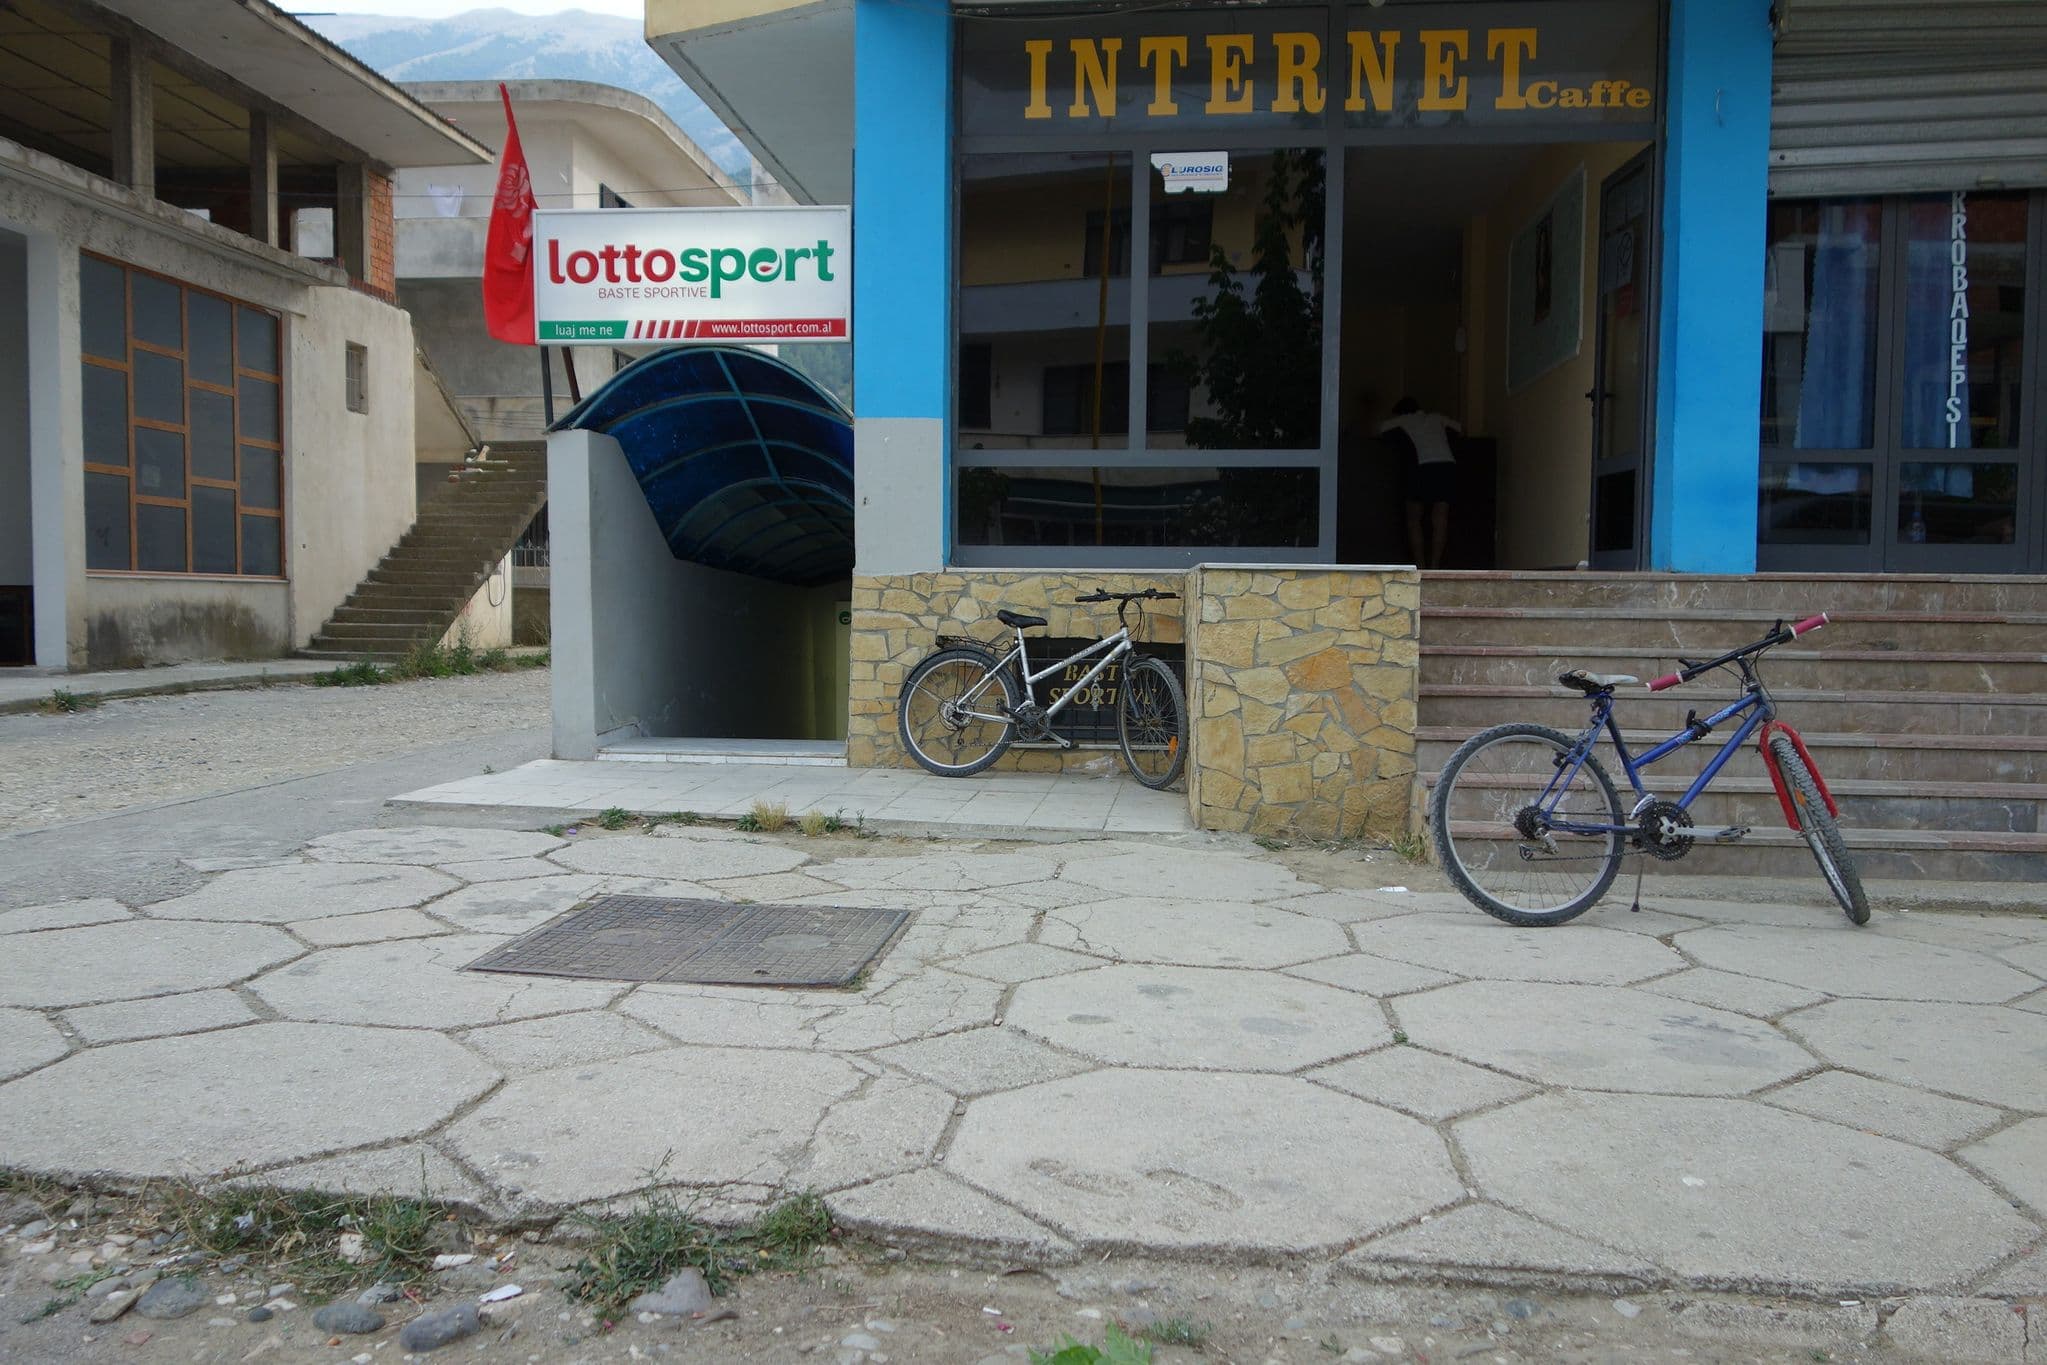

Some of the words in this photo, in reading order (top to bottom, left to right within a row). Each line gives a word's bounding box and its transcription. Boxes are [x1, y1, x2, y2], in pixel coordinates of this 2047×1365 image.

[1024, 28, 1537, 118] INTERNET
[1524, 80, 1651, 108] Caffe
[548, 239, 834, 298] lottosport
[598, 287, 640, 299] BASTE
[643, 286, 707, 299] SPORTIVE
[555, 324, 575, 338] luaj
[579, 326, 596, 335] me
[599, 326, 613, 335] ne
[711, 321, 832, 335] www.lottosport.com.al
